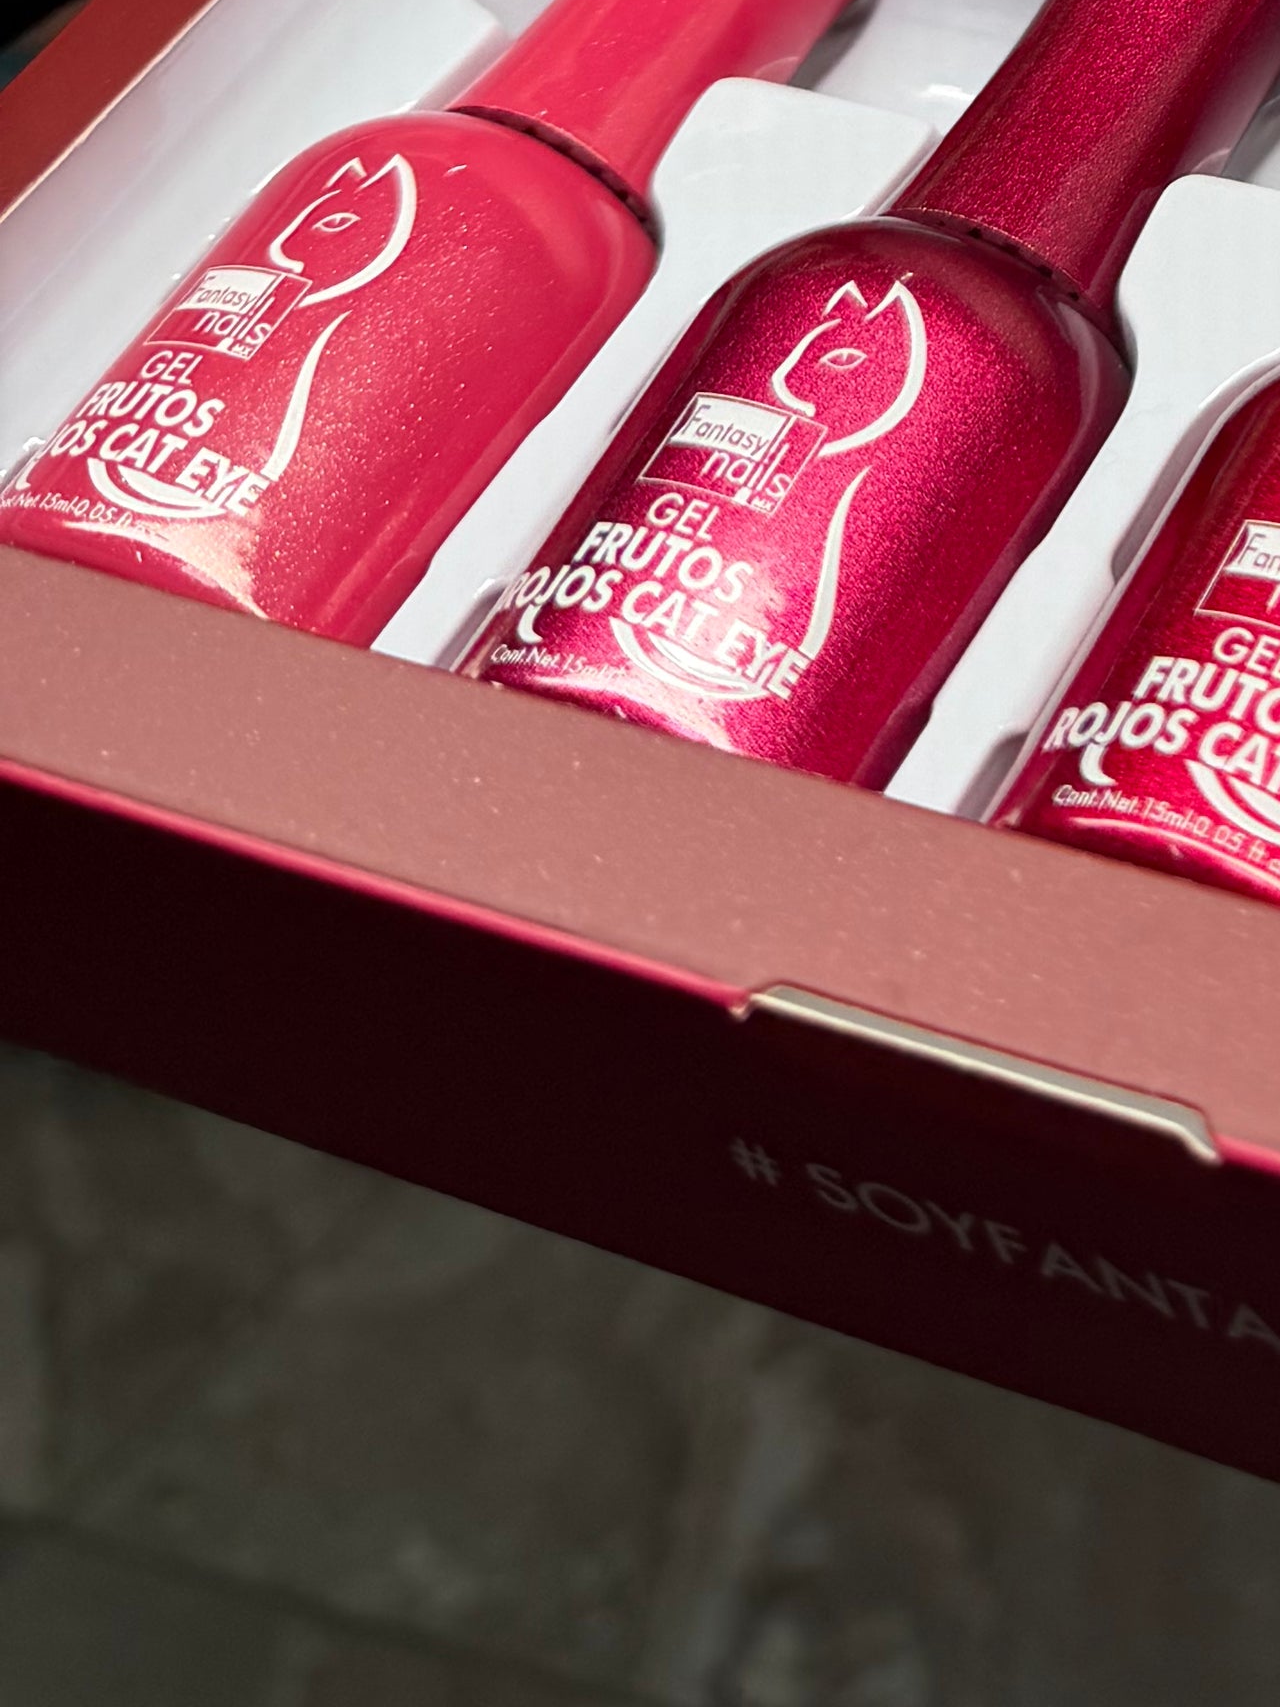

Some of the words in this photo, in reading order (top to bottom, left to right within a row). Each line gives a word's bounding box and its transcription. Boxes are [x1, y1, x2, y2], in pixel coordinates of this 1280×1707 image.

[193, 297, 275, 344] nails
[140, 350, 203, 385] GEL
[76, 381, 226, 437] FRUTOS
[682, 404, 768, 456] Fantasy
[100, 423, 188, 474] CAT
[175, 447, 271, 517] EYE
[701, 443, 793, 499] nails
[647, 492, 720, 540] GEL
[574, 521, 753, 604] FRUTOS
[621, 580, 719, 638] CAT
[715, 618, 813, 701] EYE
[1042, 700, 1199, 755] ROJOS
